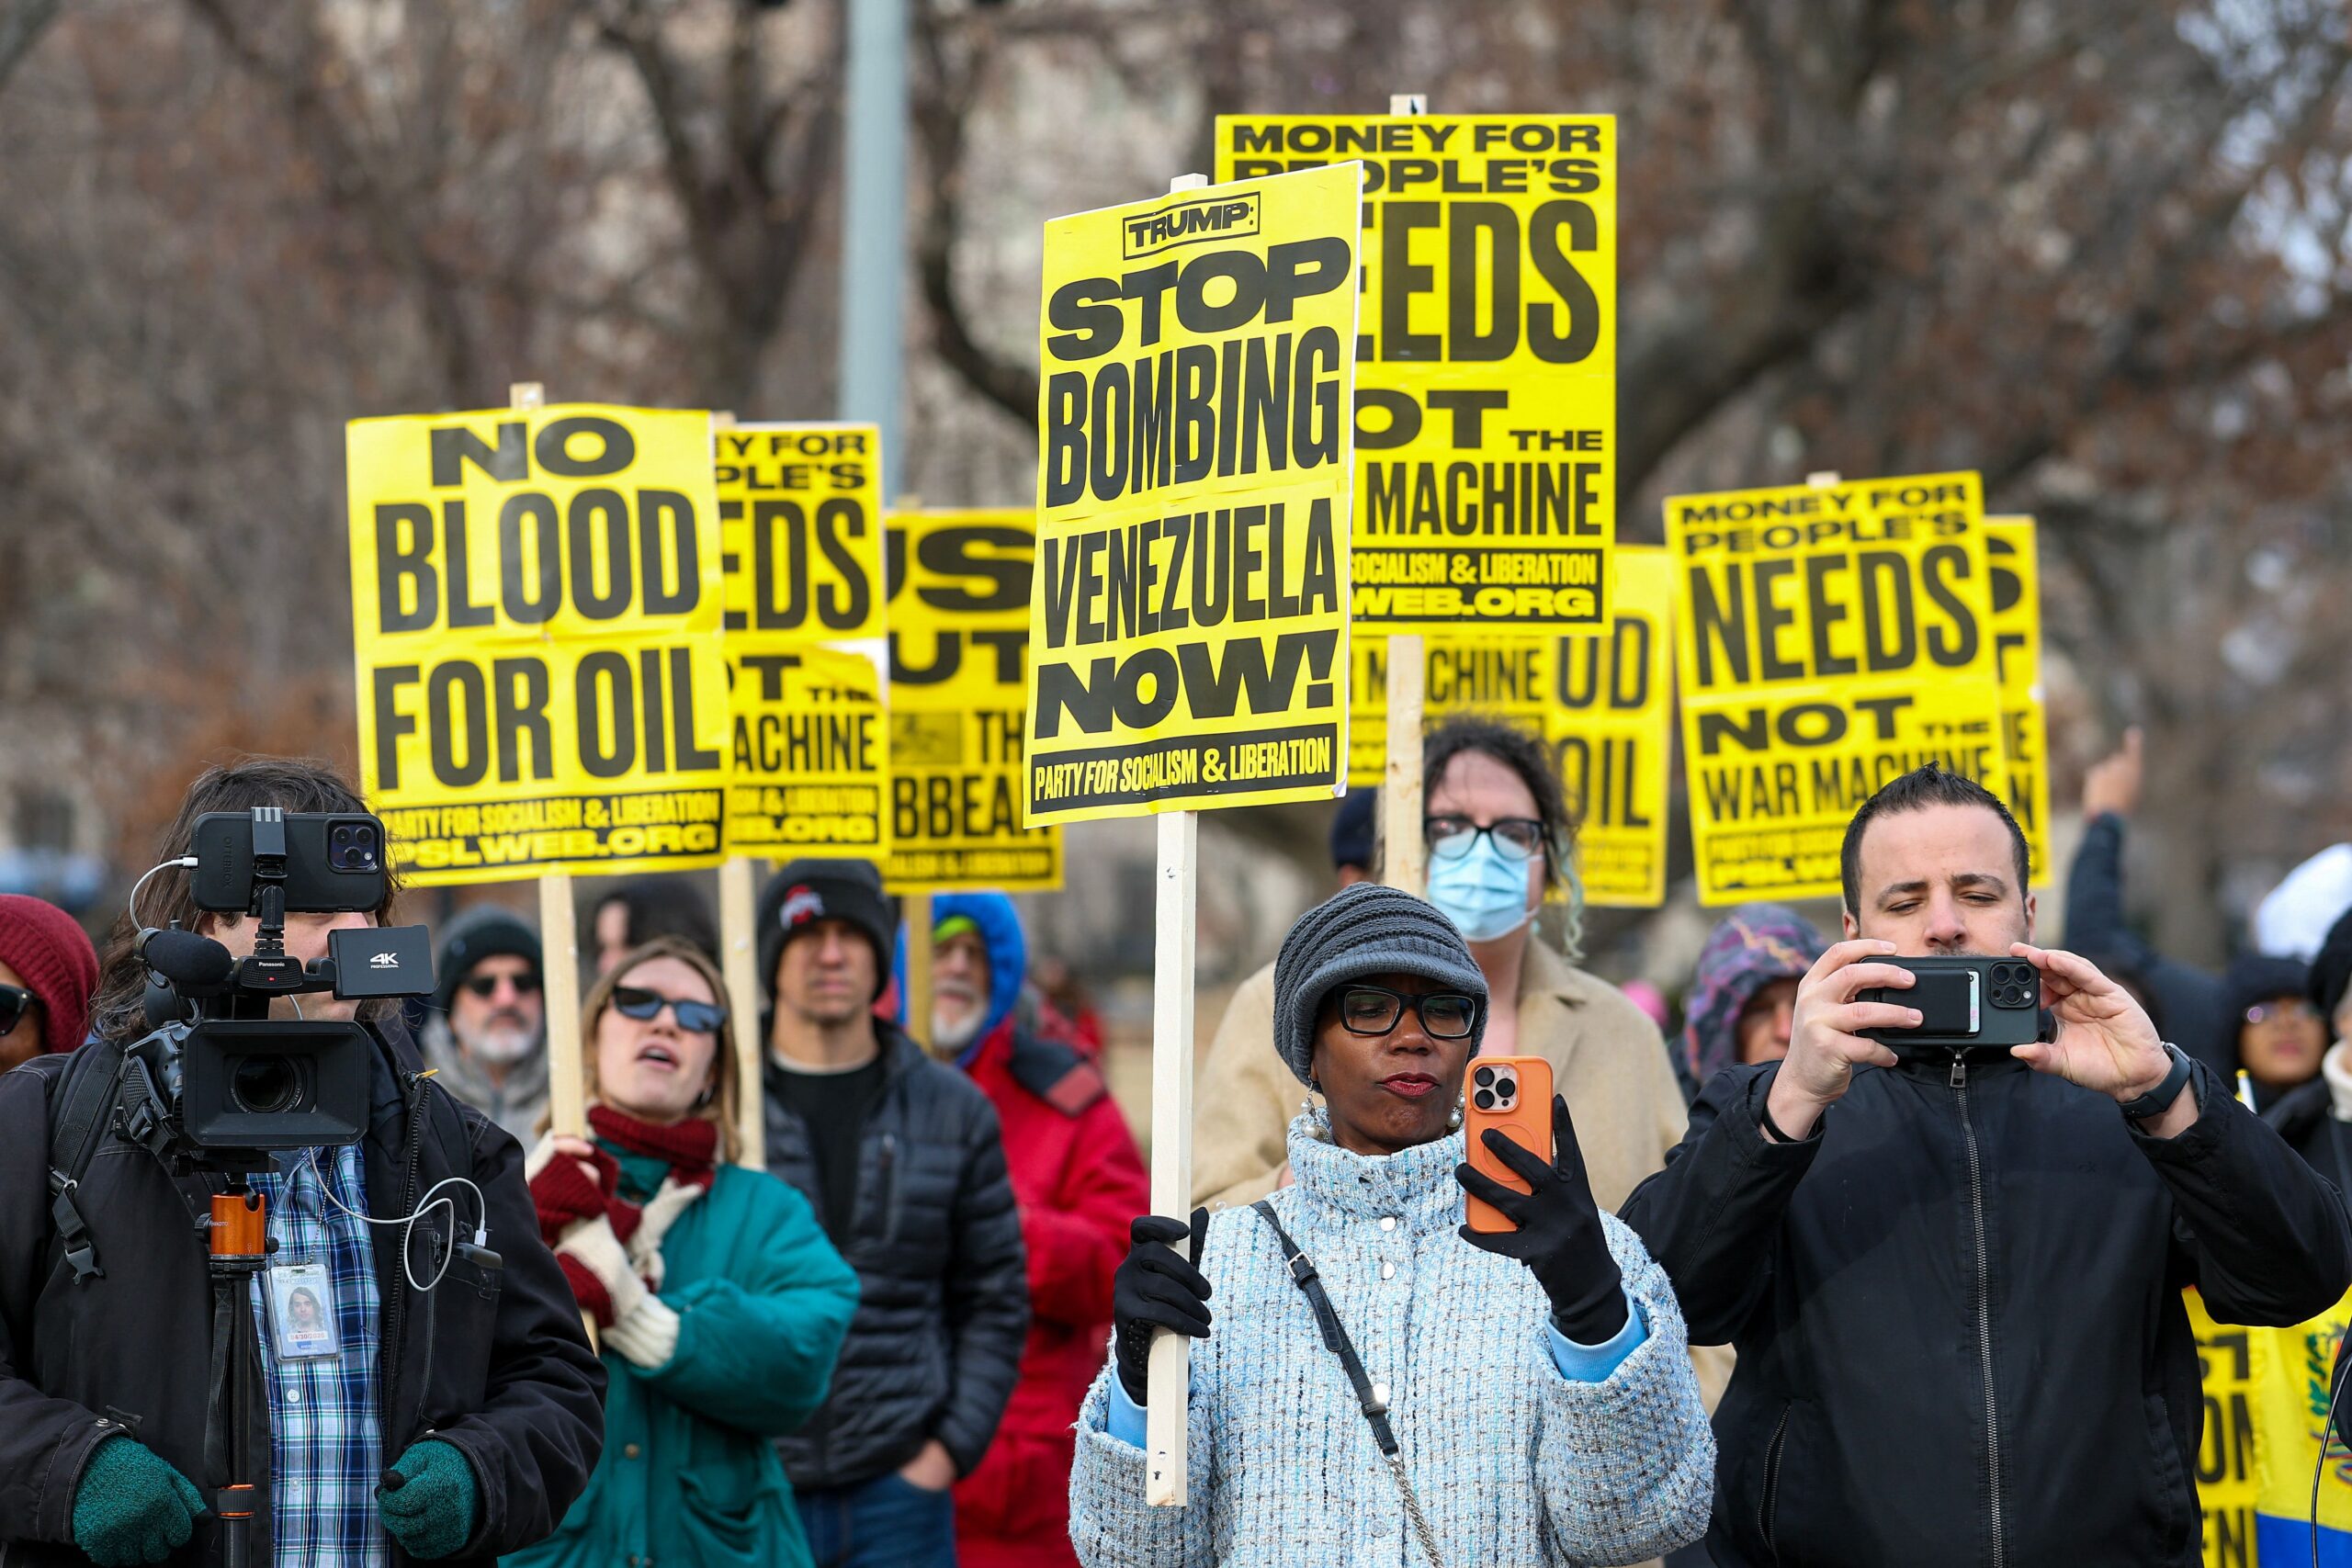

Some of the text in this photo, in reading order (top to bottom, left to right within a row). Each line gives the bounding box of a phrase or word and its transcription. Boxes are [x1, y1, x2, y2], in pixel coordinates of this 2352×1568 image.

[1234, 124, 1601, 153] MONEY FOR
[1234, 158, 1601, 194] POPLE'S
[1129, 201, 1254, 247] TRUMP:
[1047, 236, 1351, 361] STOP
[1357, 199, 1601, 364] EDS
[770, 434, 866, 457] FOR
[1046, 325, 1340, 508] BOMBING
[1353, 389, 1602, 451] OT THE
[430, 416, 635, 487] NO
[716, 463, 866, 490] PLE'S
[1366, 461, 1601, 536] MACHINE
[1683, 484, 1966, 525] MONEY FOR
[374, 489, 700, 634] BLOOD
[1686, 511, 1969, 556] PEOPLE'S
[1044, 497, 1339, 649] VENEZUELA
[1449, 554, 1477, 585] &
[1480, 553, 1597, 584] LIBERATION
[1351, 587, 1595, 617] WEB.ORG
[1689, 544, 1978, 687] NEEDS
[888, 630, 1029, 685] UT
[1035, 628, 1339, 739] NOW!
[1367, 648, 1542, 705] MCHINE
[374, 647, 720, 791] FOR OIL
[734, 714, 876, 773] ACHINE
[974, 710, 1025, 764] TH
[1699, 696, 1914, 756] NOT
[1035, 761, 1084, 801] PARTY
[1084, 759, 1119, 795] FOR
[1119, 749, 1197, 792] SOCIALISM
[1202, 748, 1227, 783] &
[1229, 737, 1330, 781] LIBERATION
[1704, 761, 1800, 822] WAR
[441, 805, 480, 838] FOR
[481, 797, 582, 836] SOCIALISM
[583, 797, 610, 829] &
[610, 791, 720, 827] LIBERATION
[370, 953, 400, 964] 4K
